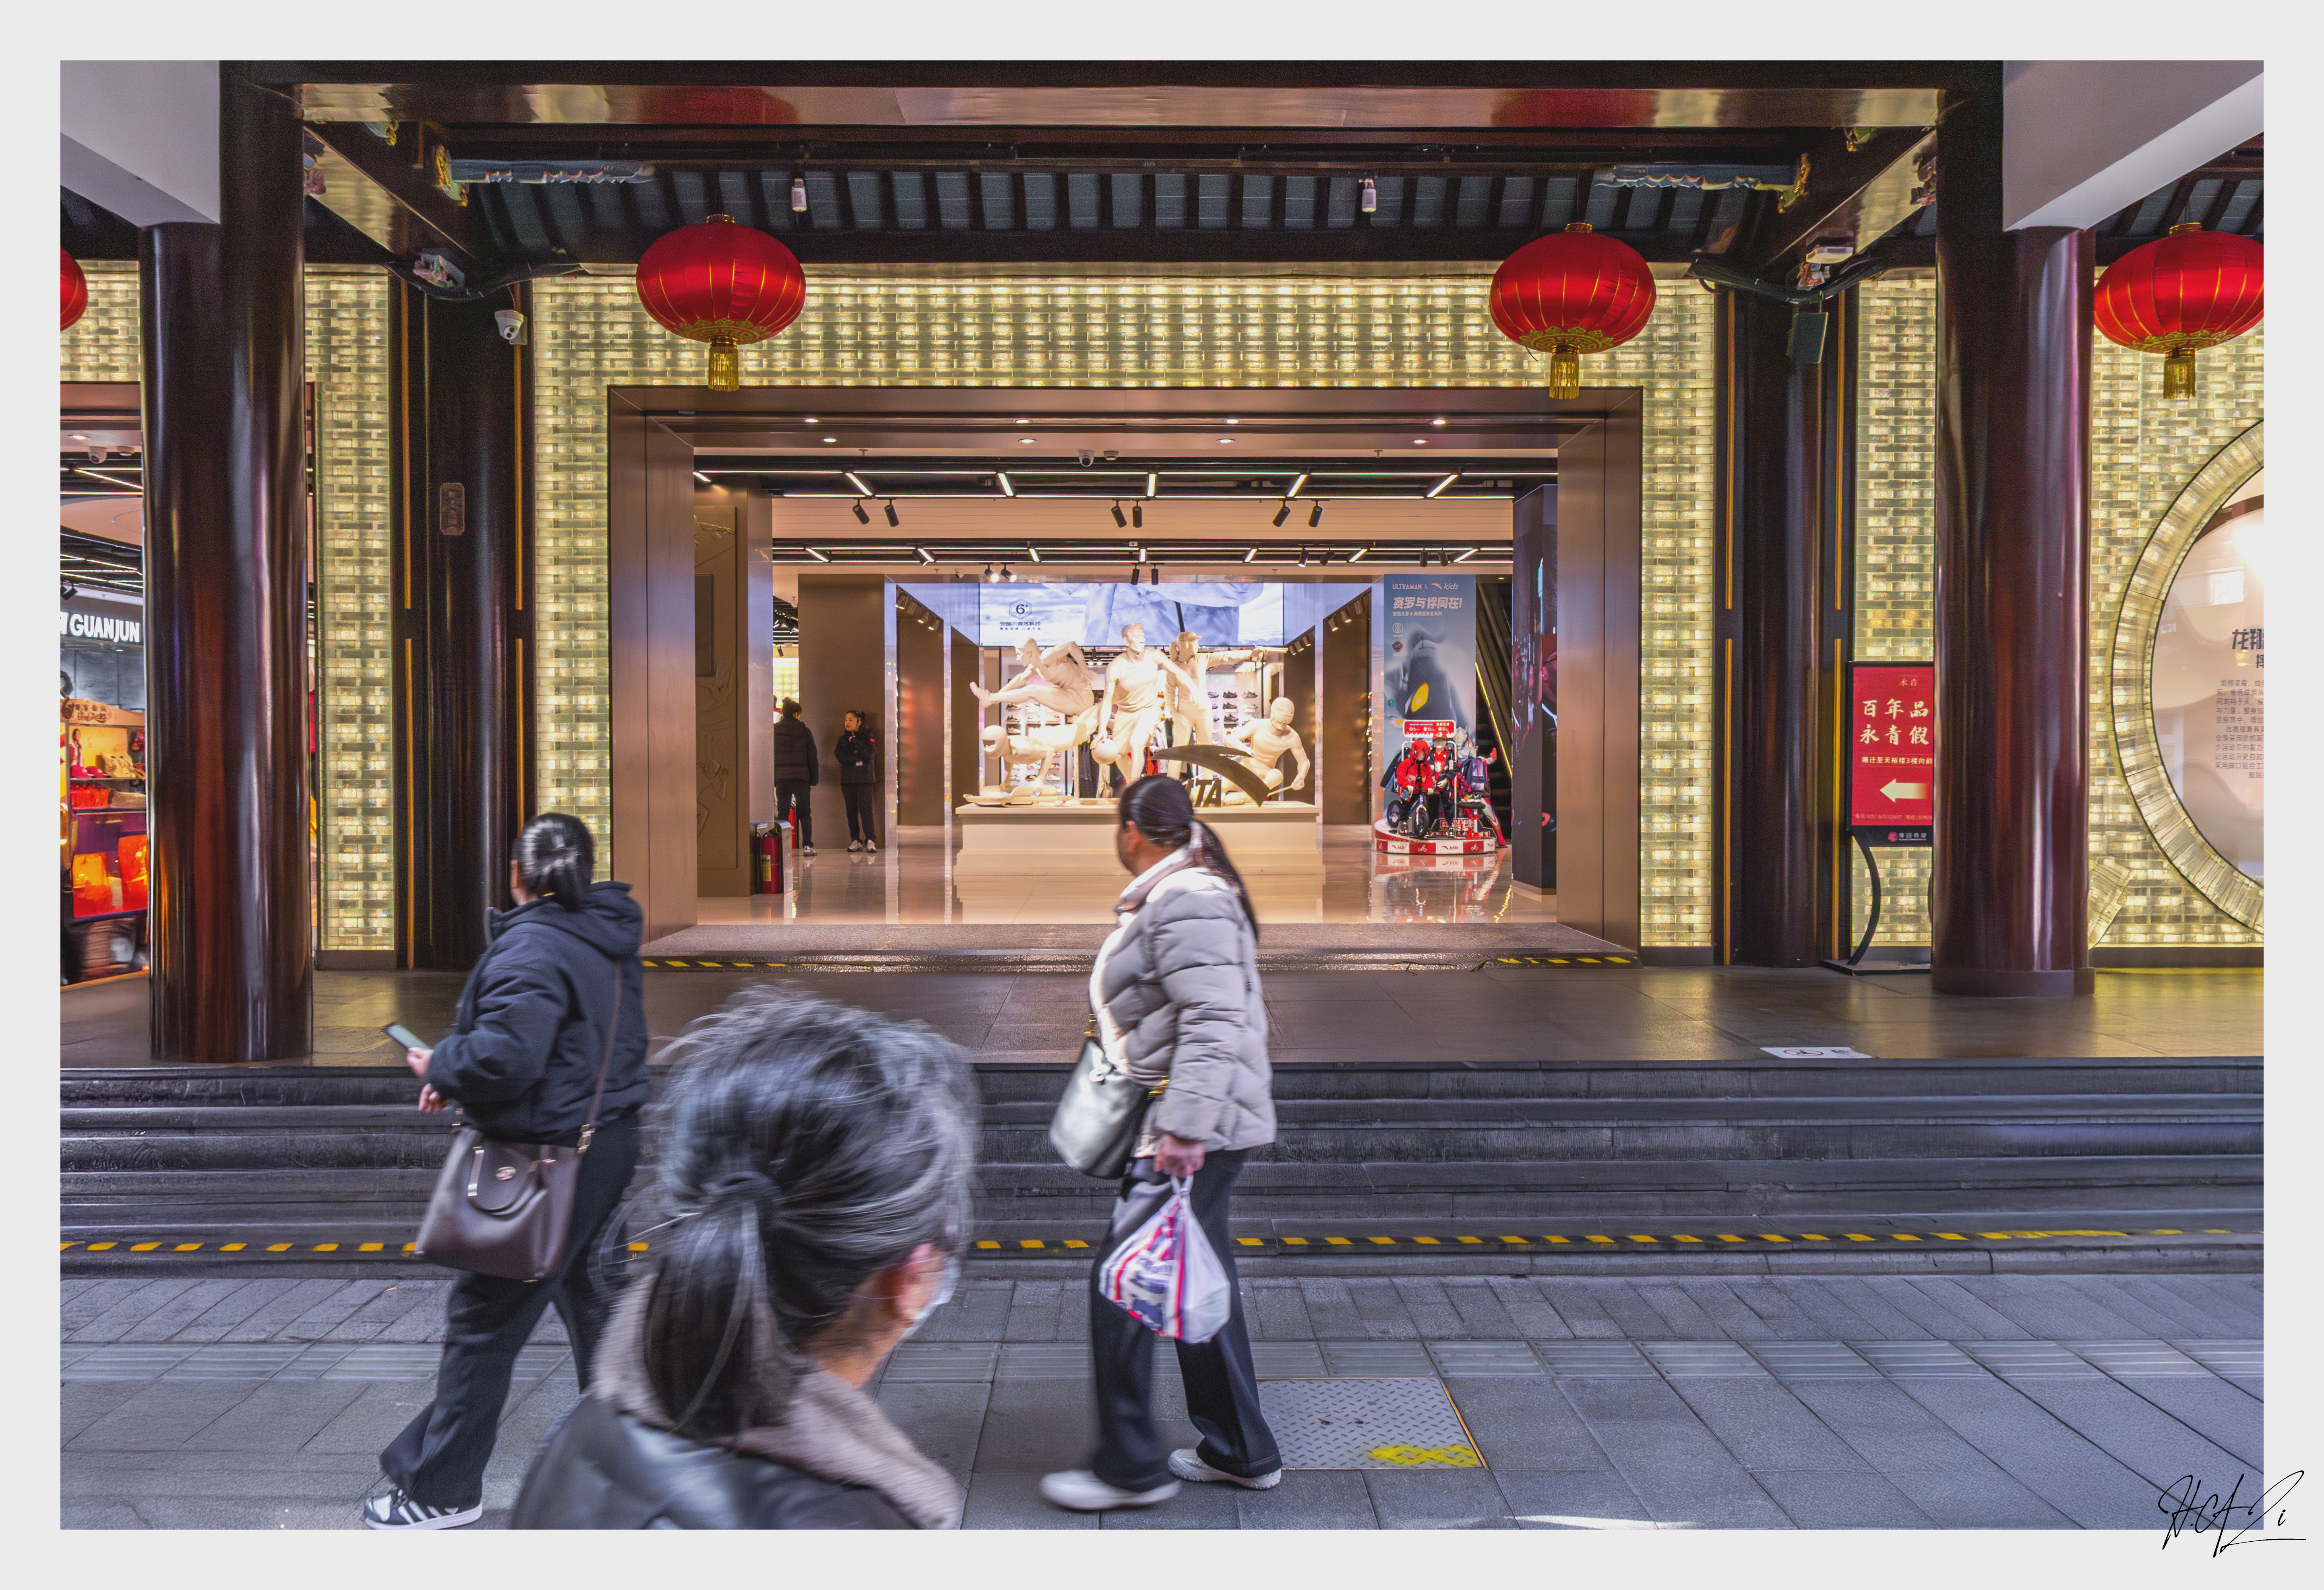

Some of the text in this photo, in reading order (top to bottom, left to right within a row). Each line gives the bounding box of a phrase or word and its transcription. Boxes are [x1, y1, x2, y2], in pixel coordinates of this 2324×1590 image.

[70, 614, 141, 643] GUANJUN
[1863, 698, 1929, 720] 百年品
[1859, 724, 1929, 745] 永青假
